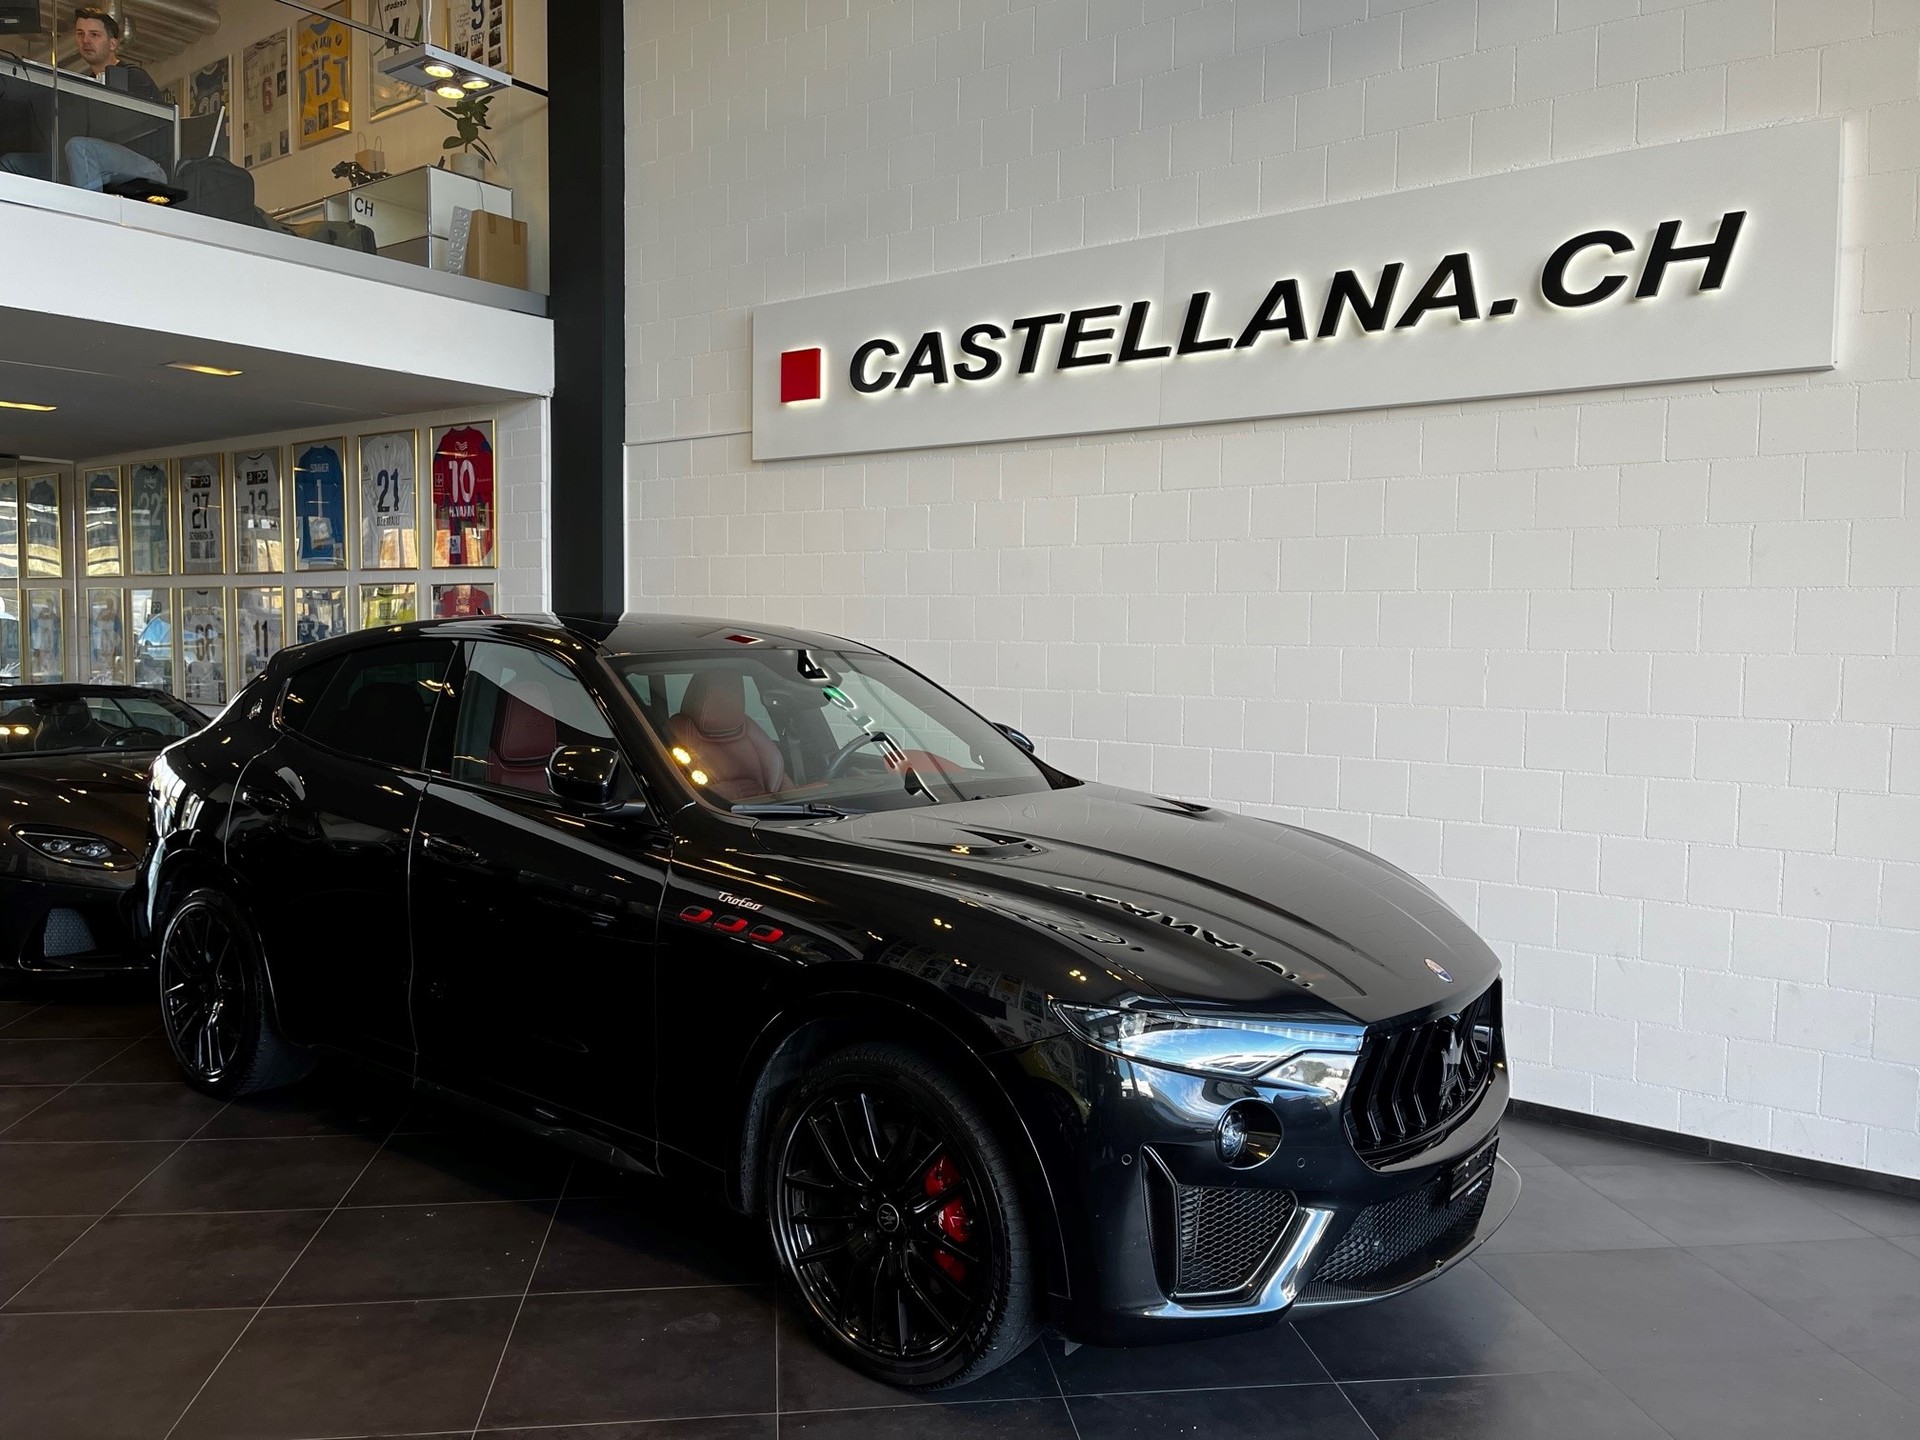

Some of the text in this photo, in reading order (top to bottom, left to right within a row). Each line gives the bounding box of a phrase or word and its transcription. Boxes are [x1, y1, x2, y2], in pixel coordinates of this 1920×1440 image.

[262, 77, 273, 114] 6
[354, 197, 374, 217] CH
[849, 210, 1747, 394] CASTELLANA.CH
[377, 468, 399, 513] 21
[448, 459, 475, 503] 10
[140, 492, 161, 526] 22
[192, 491, 209, 529] 27
[253, 619, 269, 658] 11
[718, 890, 763, 911] Trofeo
